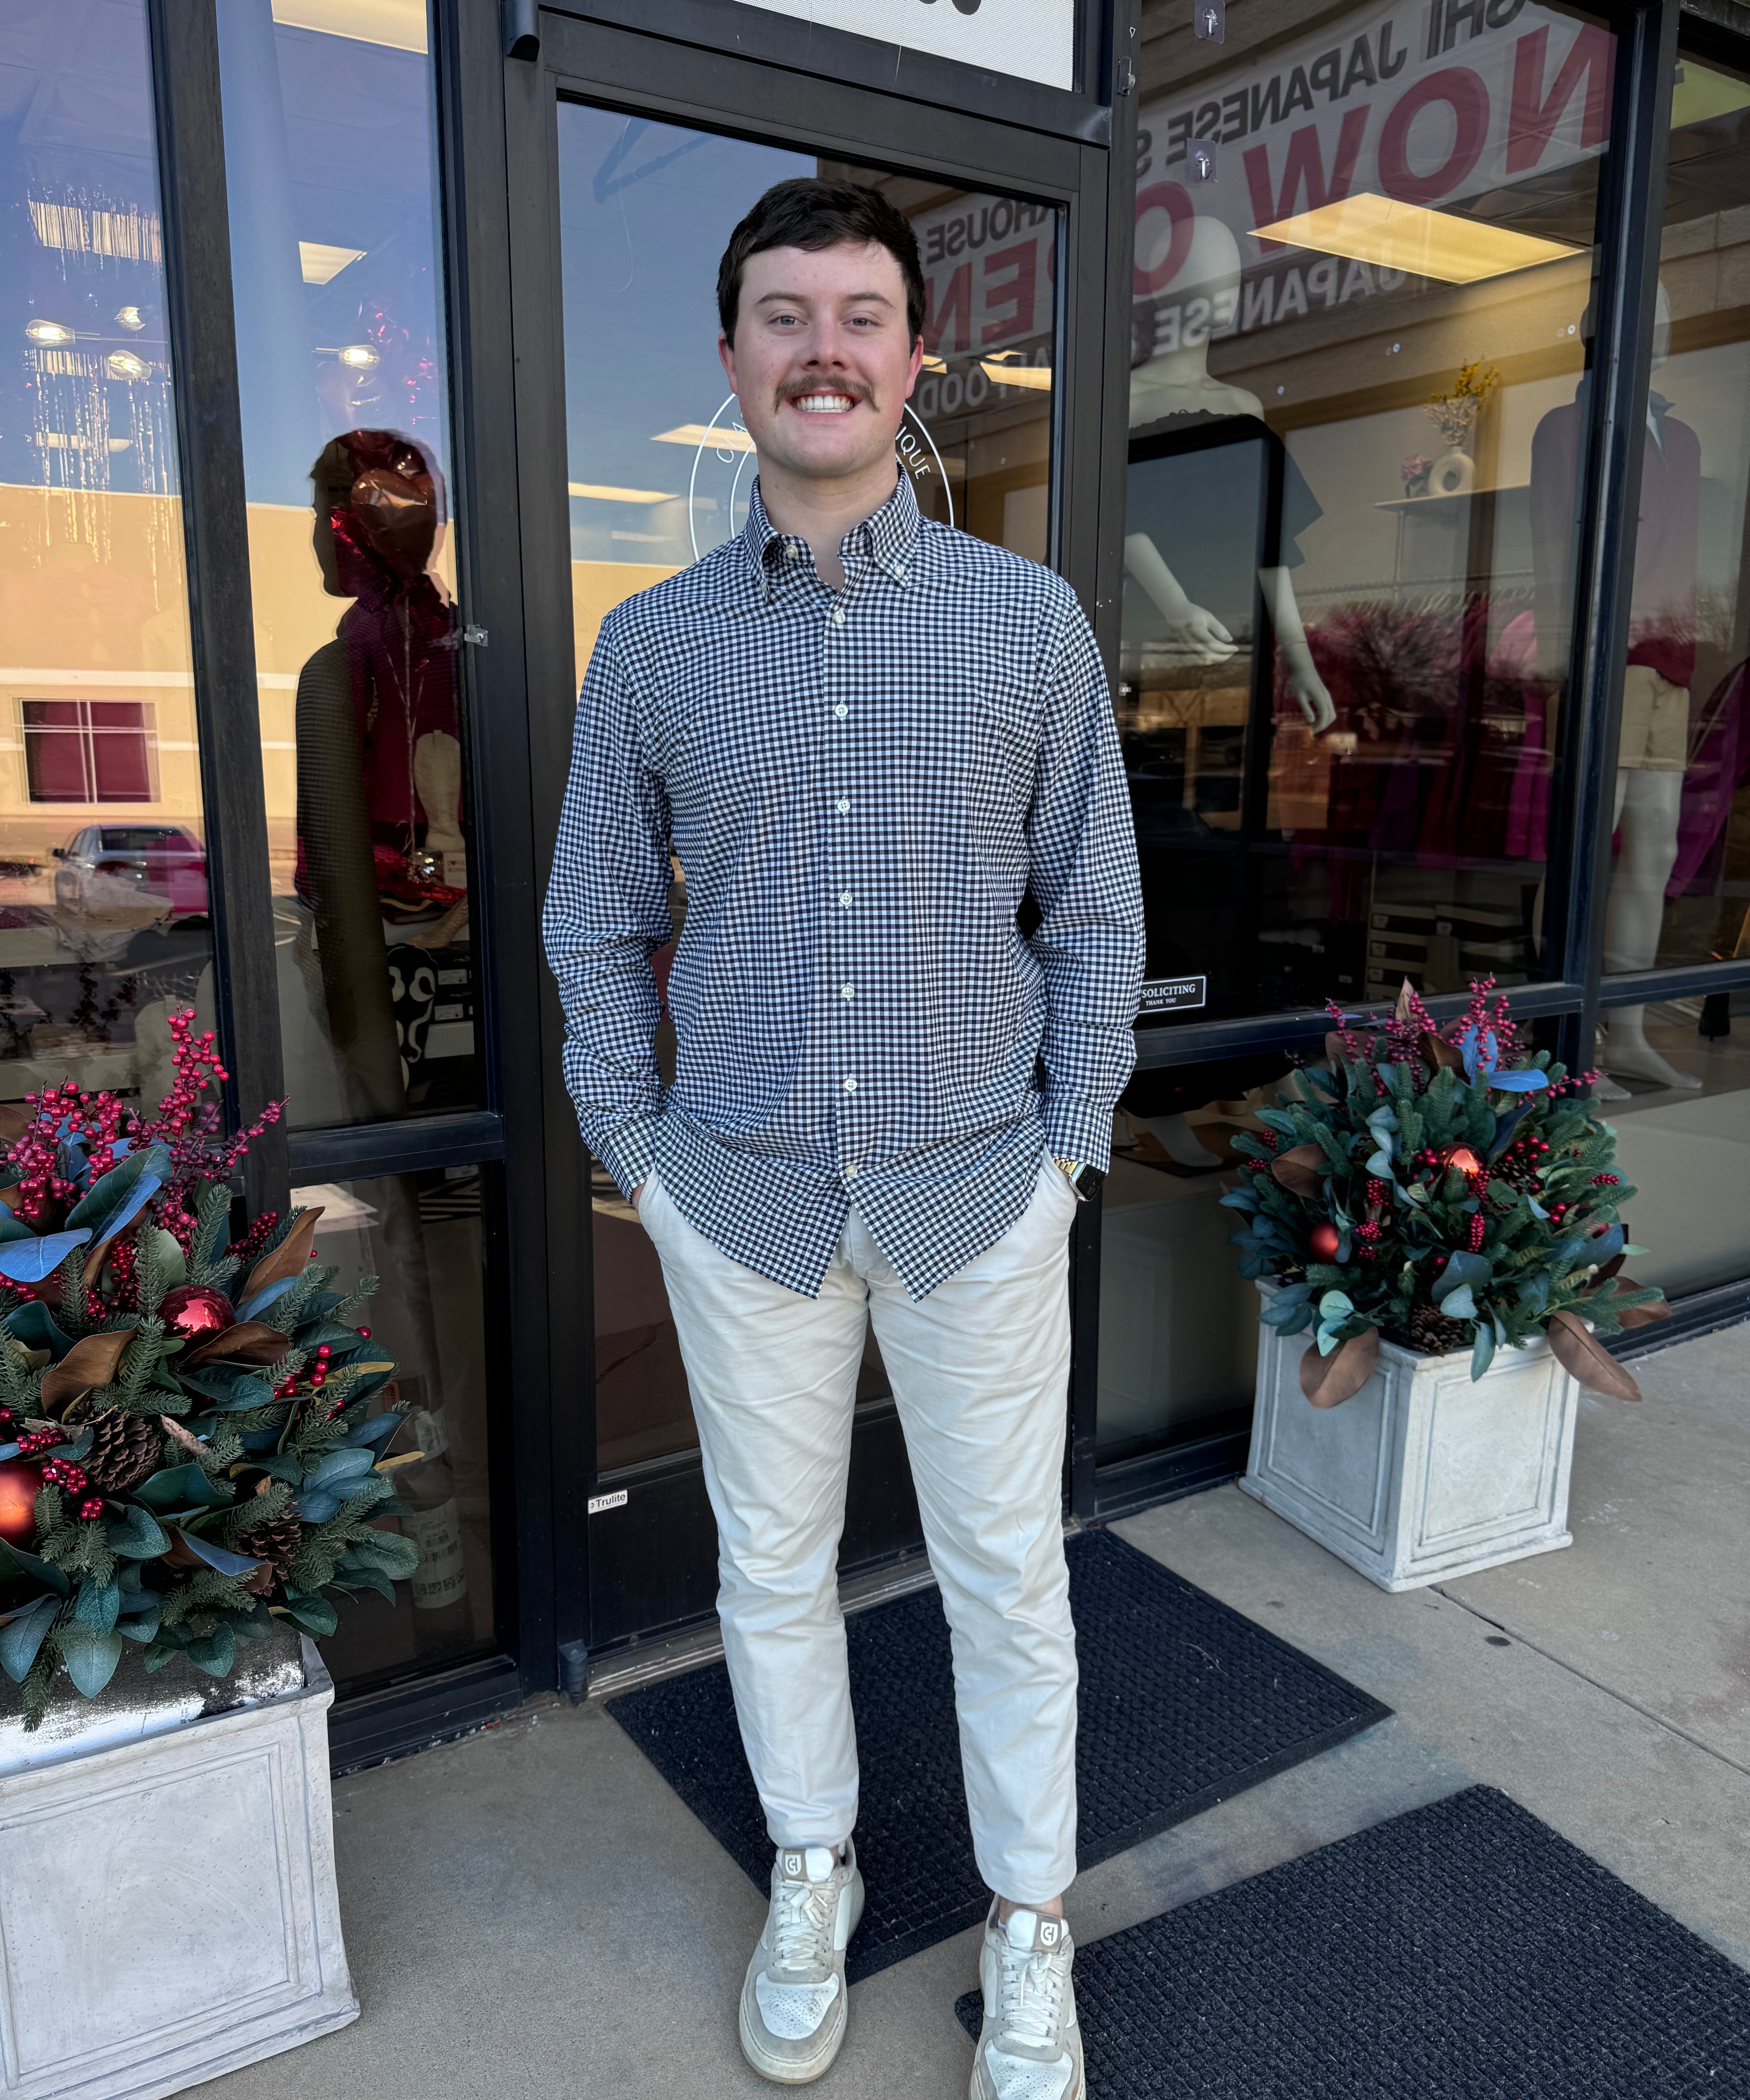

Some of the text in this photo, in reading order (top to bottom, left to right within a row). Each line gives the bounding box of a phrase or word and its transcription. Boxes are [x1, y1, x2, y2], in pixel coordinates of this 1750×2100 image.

[895, 420, 931, 480] IQUE
[1142, 984, 1196, 999] SOLICITING
[596, 1494, 625, 1507] Trulite
